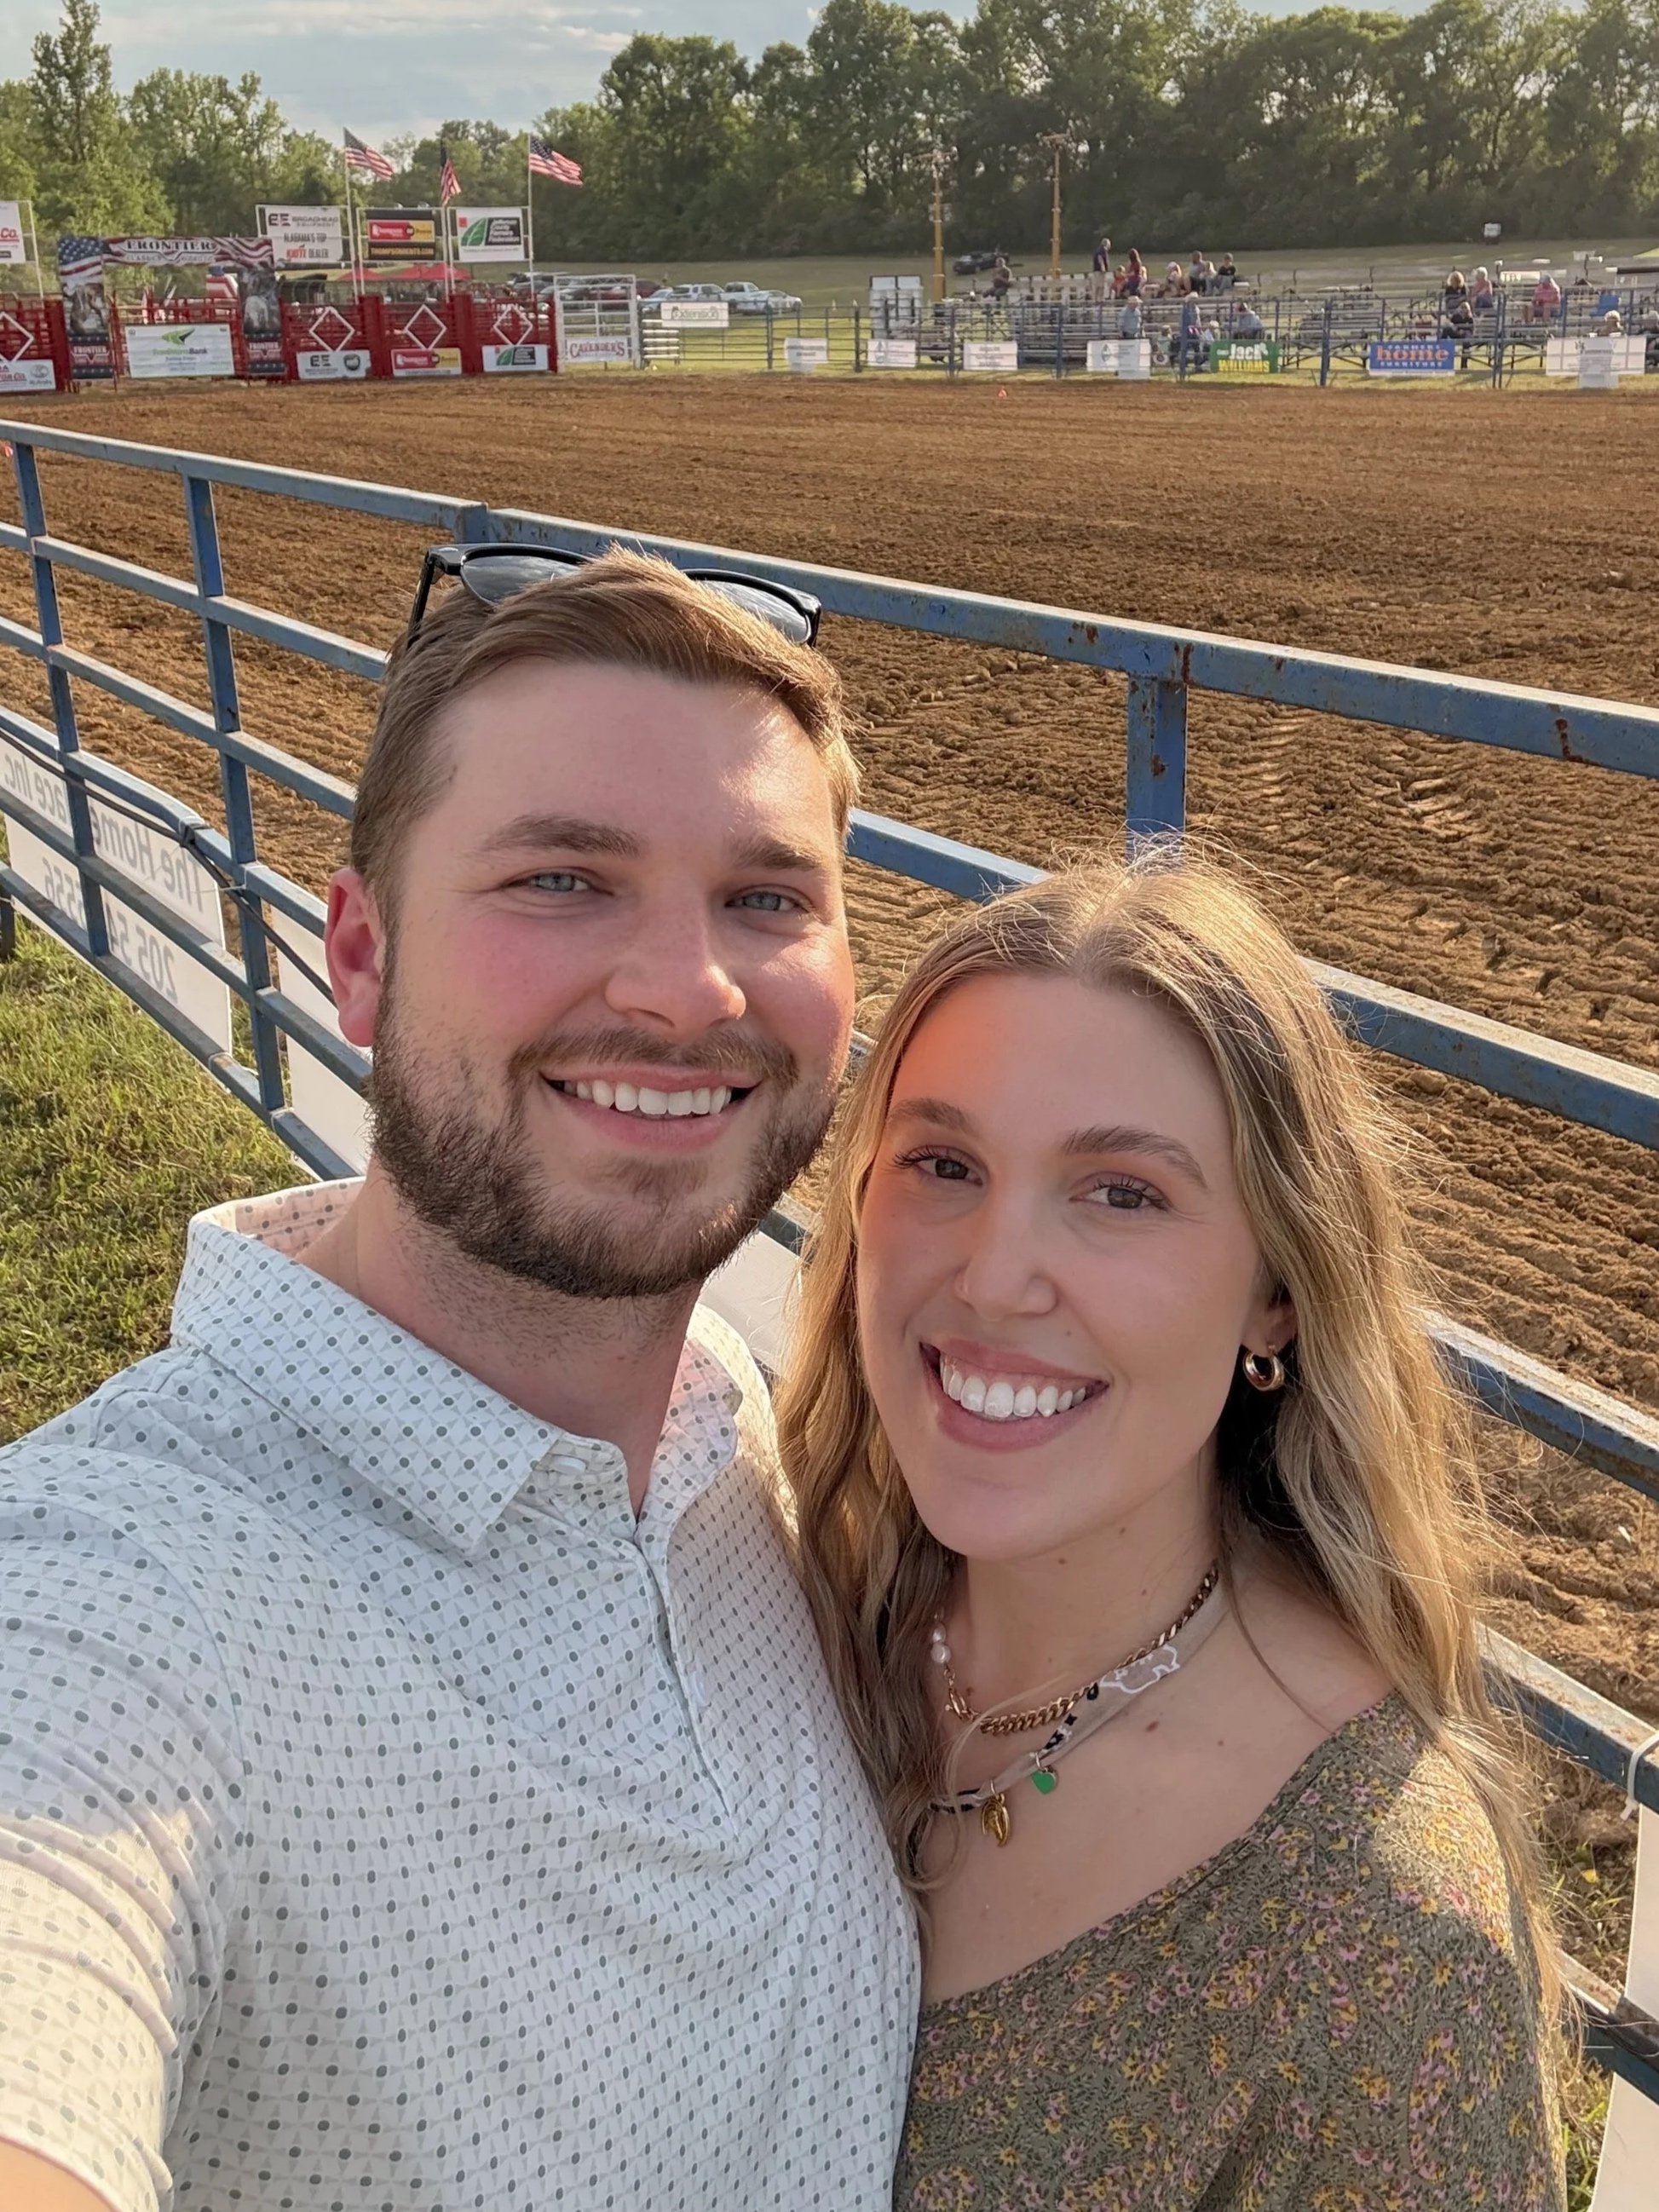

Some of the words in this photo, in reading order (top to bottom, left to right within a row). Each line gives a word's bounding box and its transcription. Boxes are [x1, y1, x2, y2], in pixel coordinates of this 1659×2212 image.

[126, 239, 217, 251] FRONTIER
[569, 341, 625, 358] CAVENDER'S
[1377, 345, 1449, 360] home
[1218, 359, 1270, 372] WILLIAMS
